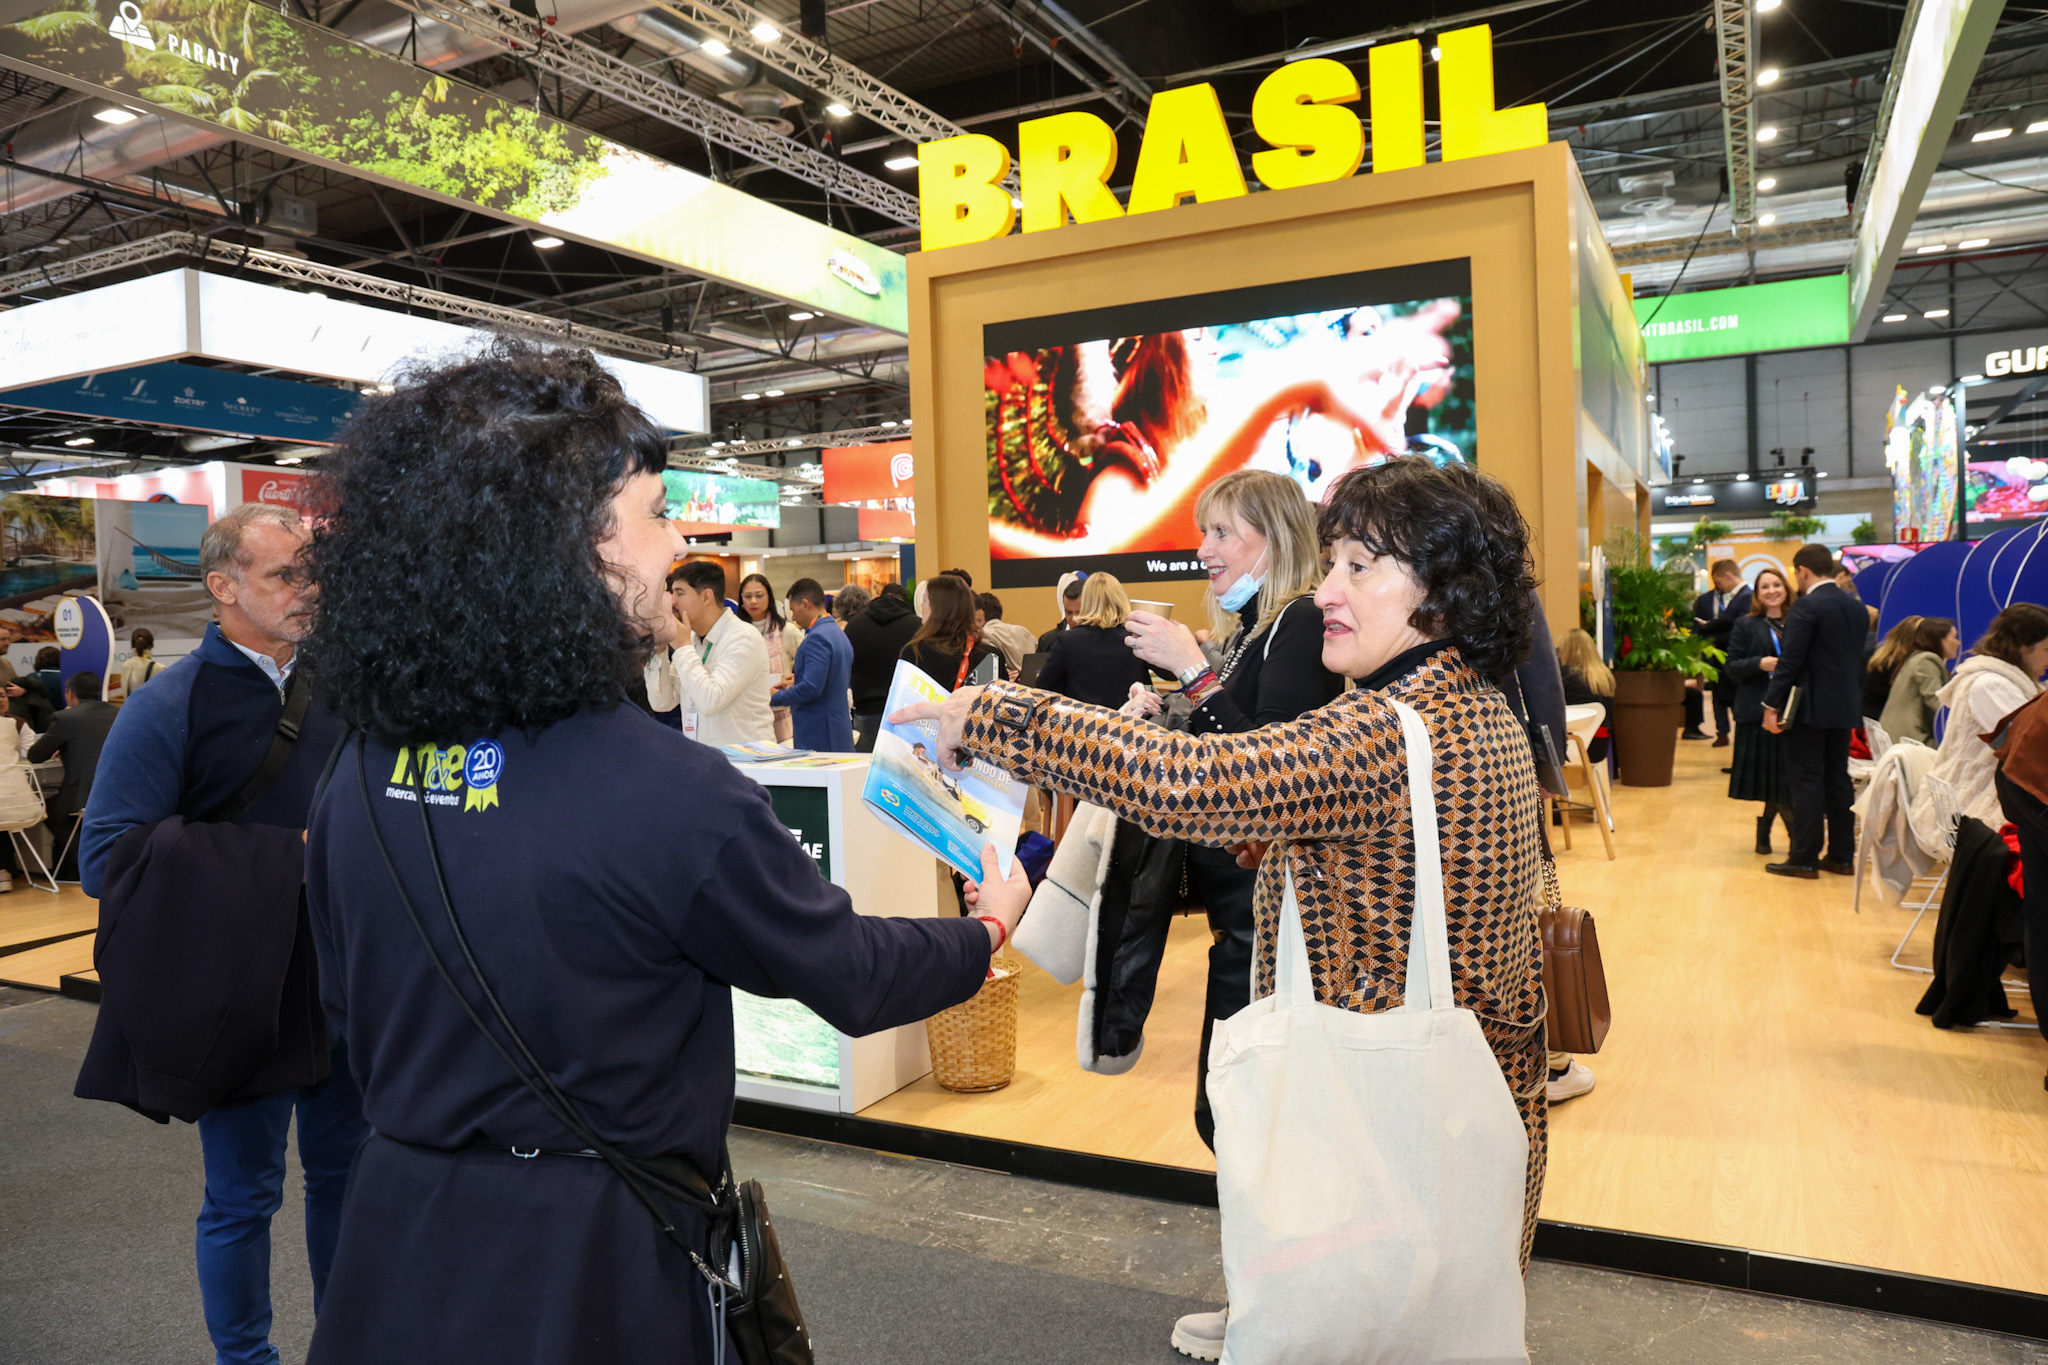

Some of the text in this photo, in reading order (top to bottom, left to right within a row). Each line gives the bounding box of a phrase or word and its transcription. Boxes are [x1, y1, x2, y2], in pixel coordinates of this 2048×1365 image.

[168, 32, 240, 76] PARATY
[917, 23, 1549, 252] BRASIL
[1146, 560, 1167, 572] We
[1169, 561, 1188, 571] are
[1190, 561, 1198, 570] a
[472, 748, 496, 772] 20
[472, 769, 495, 781] ANOS
